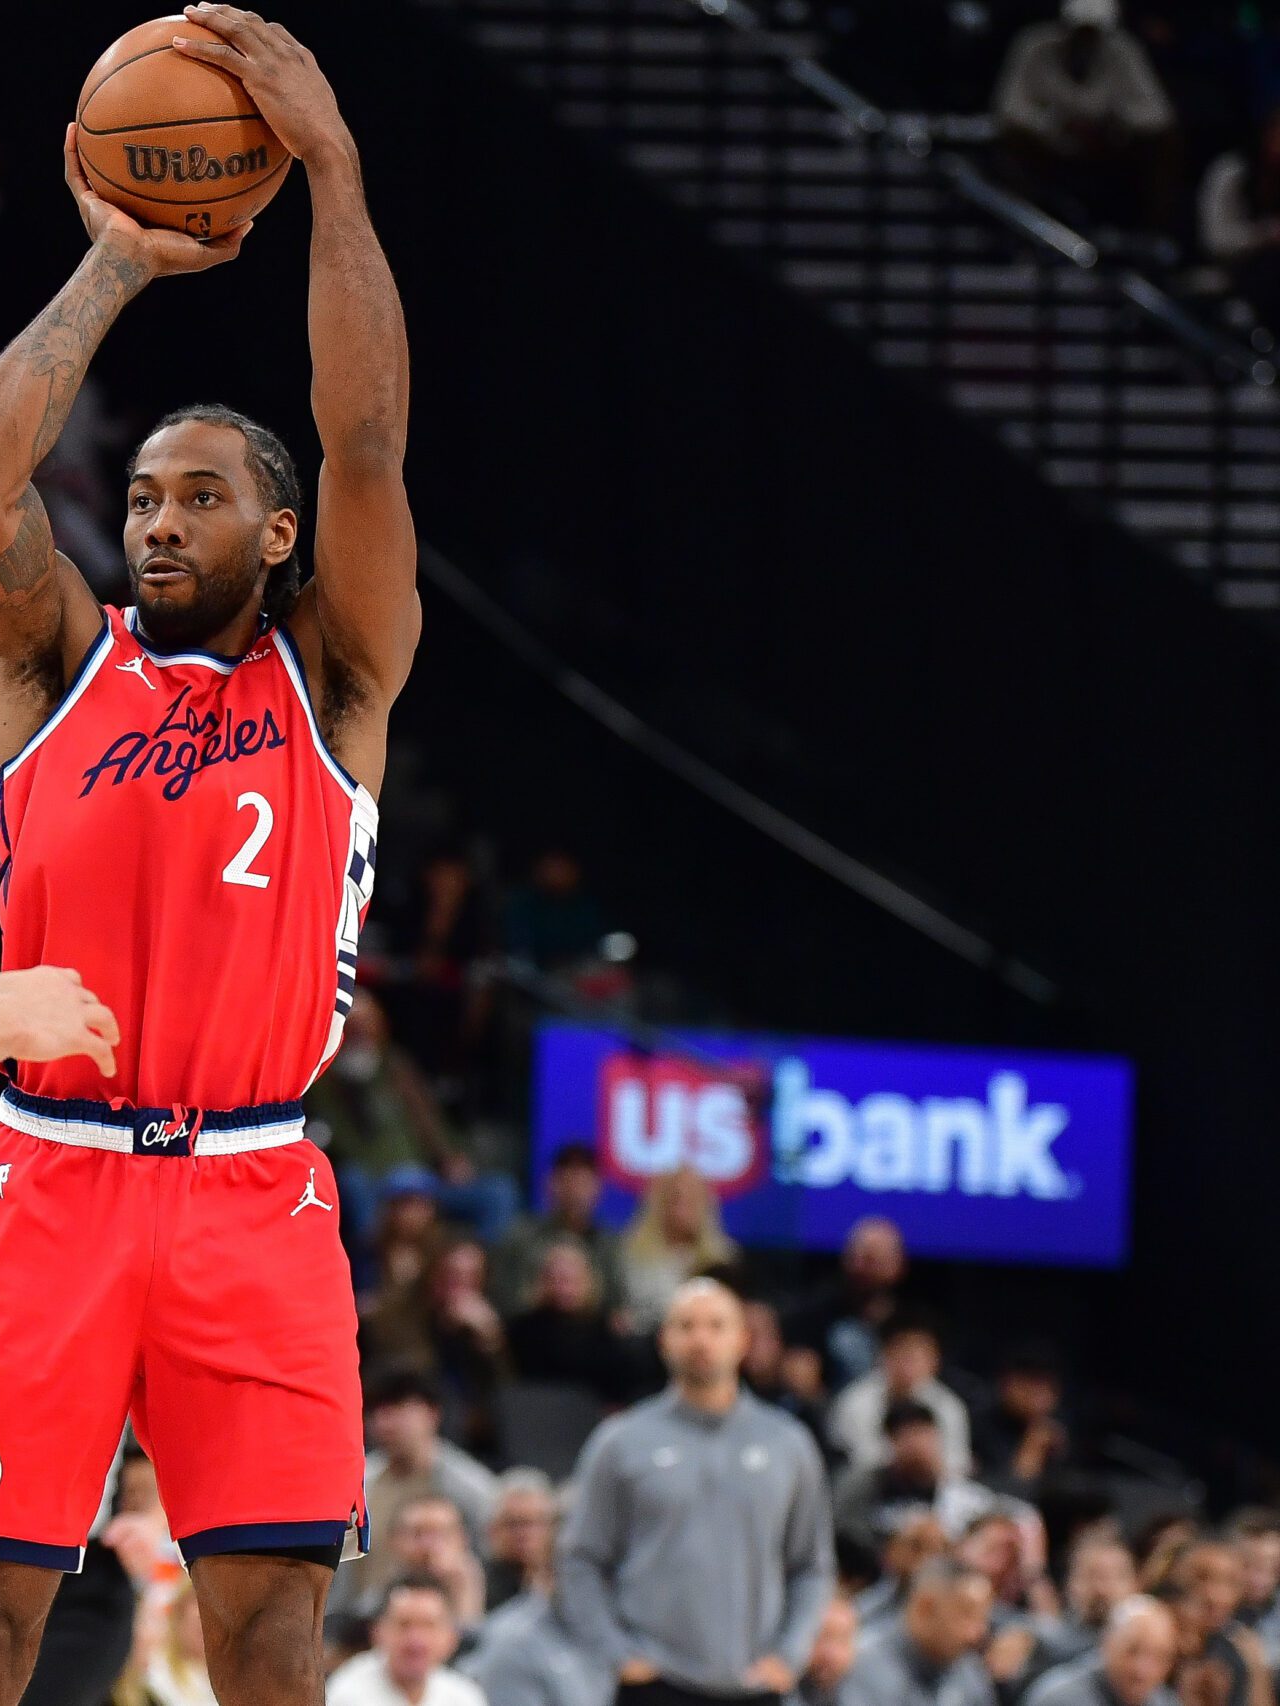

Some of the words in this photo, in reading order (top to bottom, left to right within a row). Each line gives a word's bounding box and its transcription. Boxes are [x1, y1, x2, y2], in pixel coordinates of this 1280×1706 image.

[123, 144, 269, 184] Wilson
[78, 707, 287, 801] Angeles
[152, 685, 221, 739] Los
[221, 791, 274, 889] 2
[609, 1077, 757, 1183] us
[771, 1054, 1072, 1201] bank
